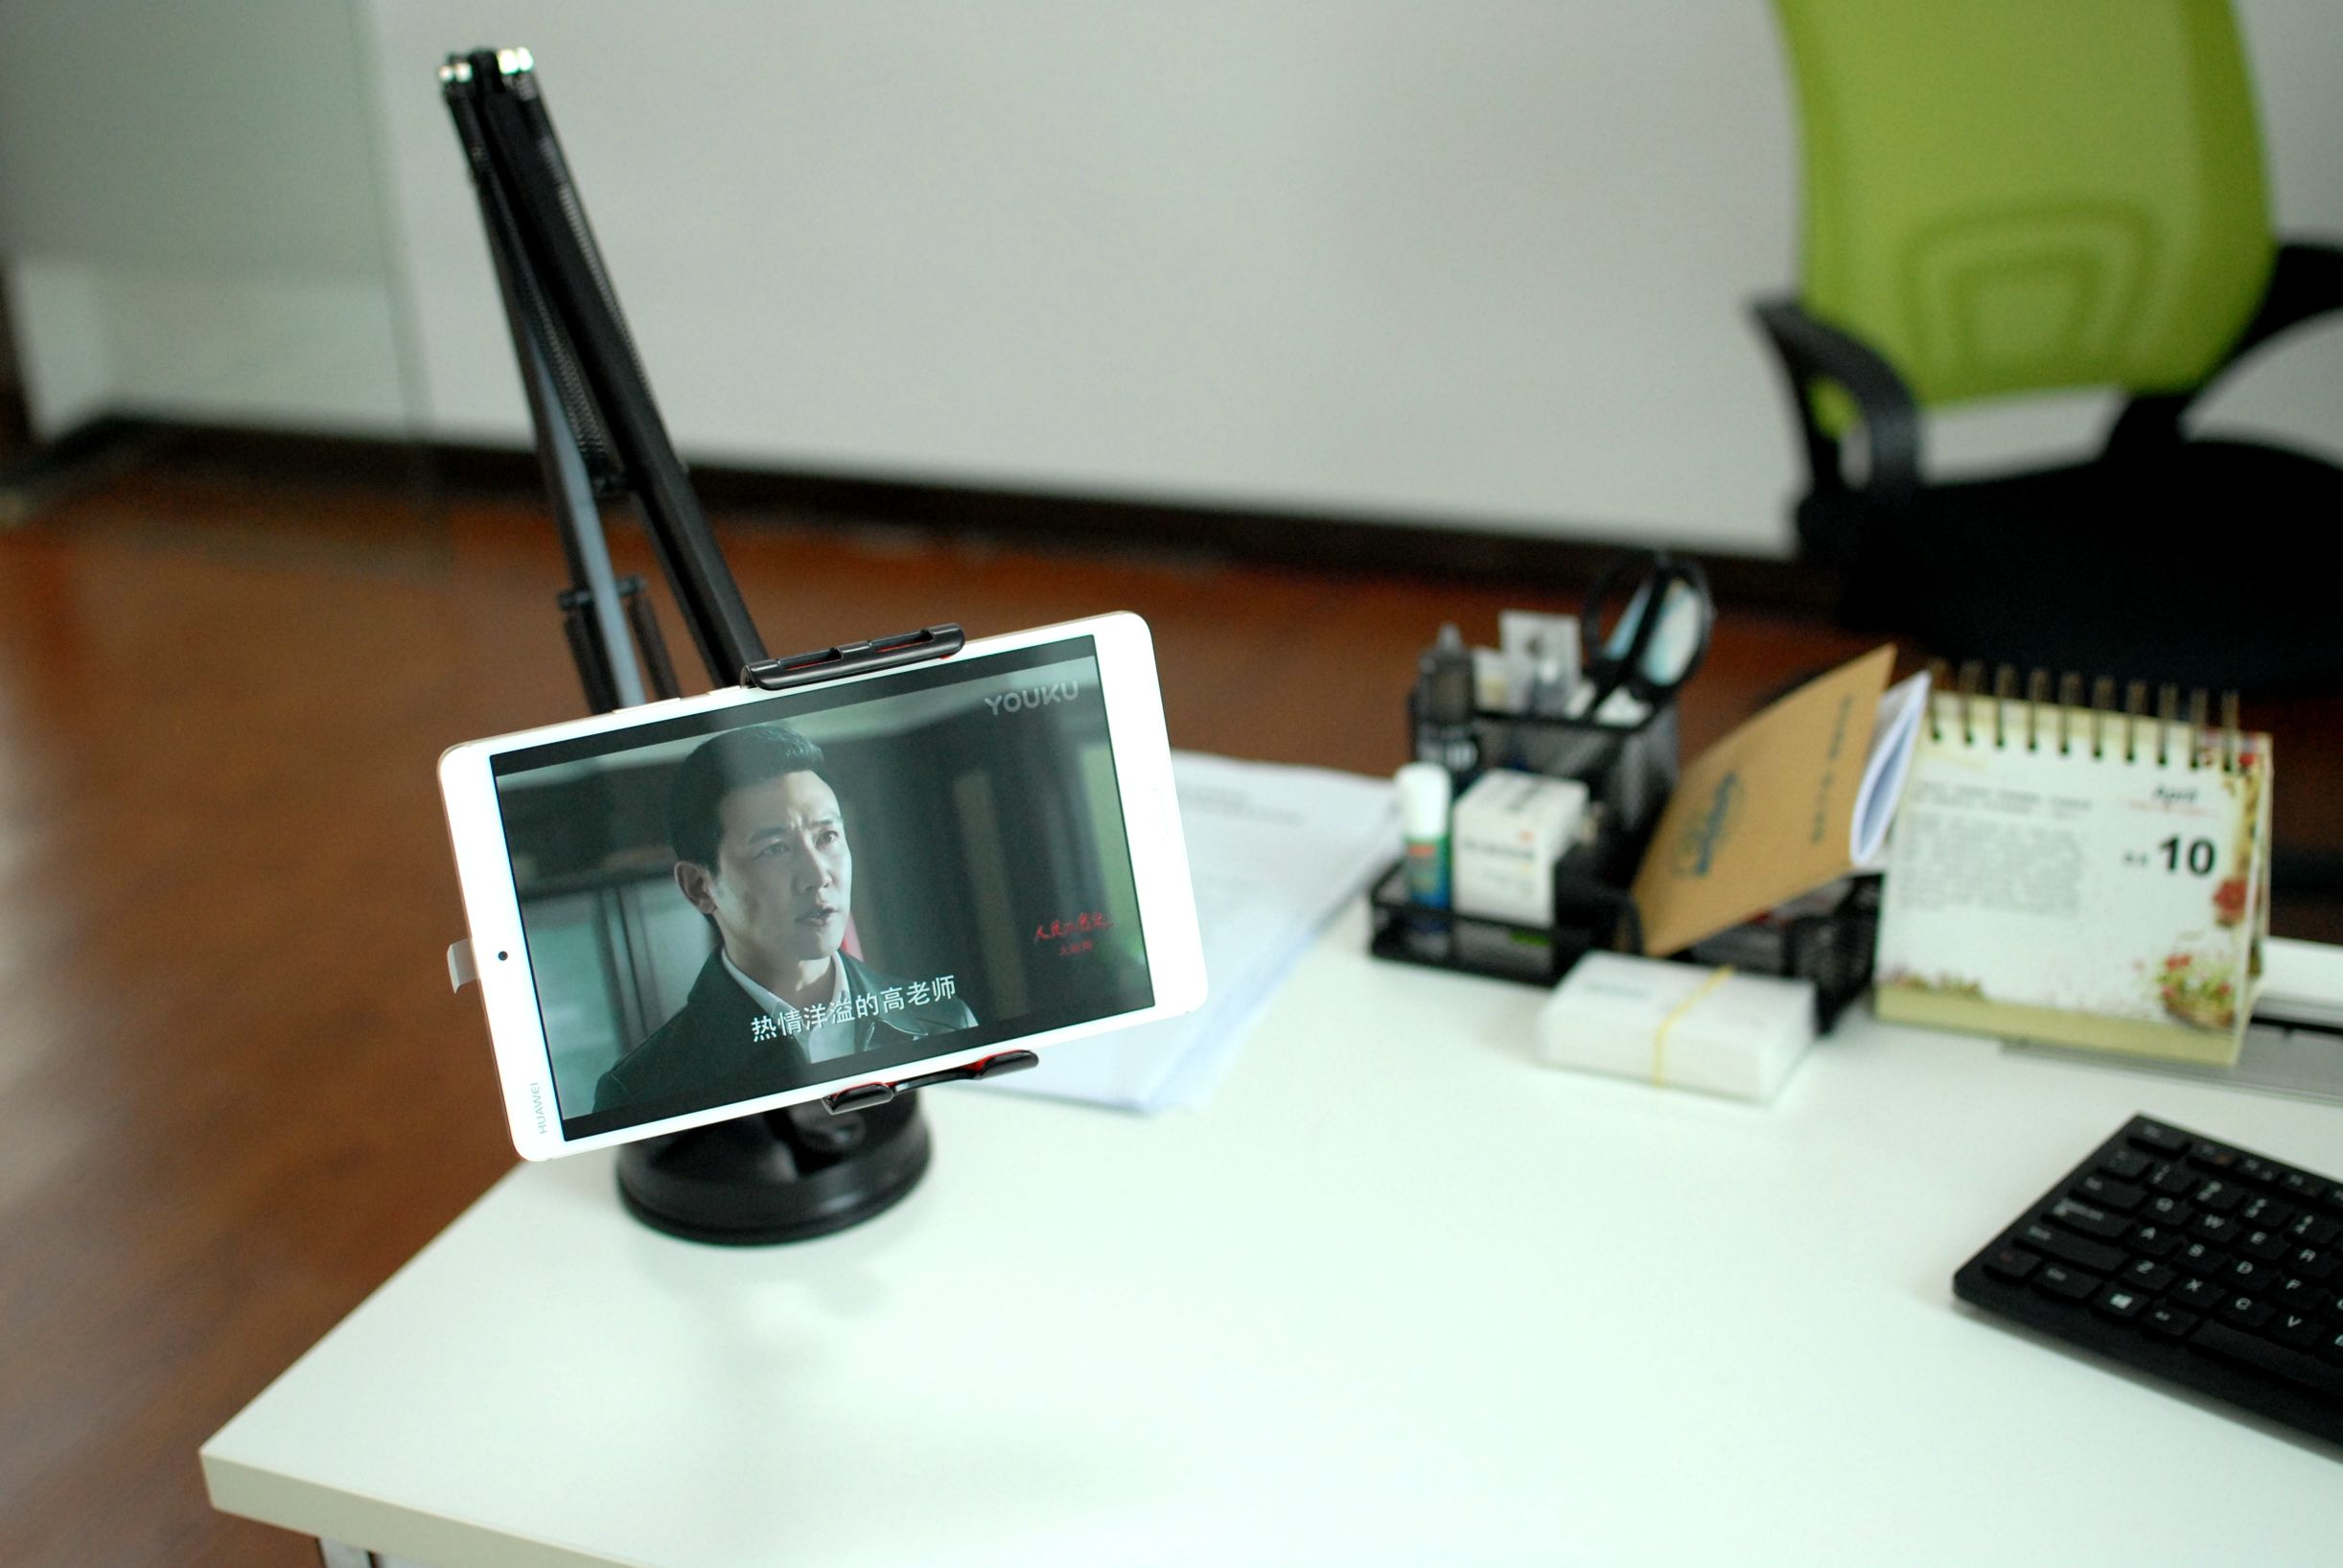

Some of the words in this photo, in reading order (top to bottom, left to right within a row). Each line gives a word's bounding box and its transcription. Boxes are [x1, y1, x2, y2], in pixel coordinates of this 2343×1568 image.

[984, 680, 1079, 715] YOUKU
[2158, 834, 2217, 877] 10
[752, 975, 956, 1042] 热情洋溢的高老师
[530, 1082, 548, 1135] HUAWEI
[2287, 1315, 2302, 1327] V
